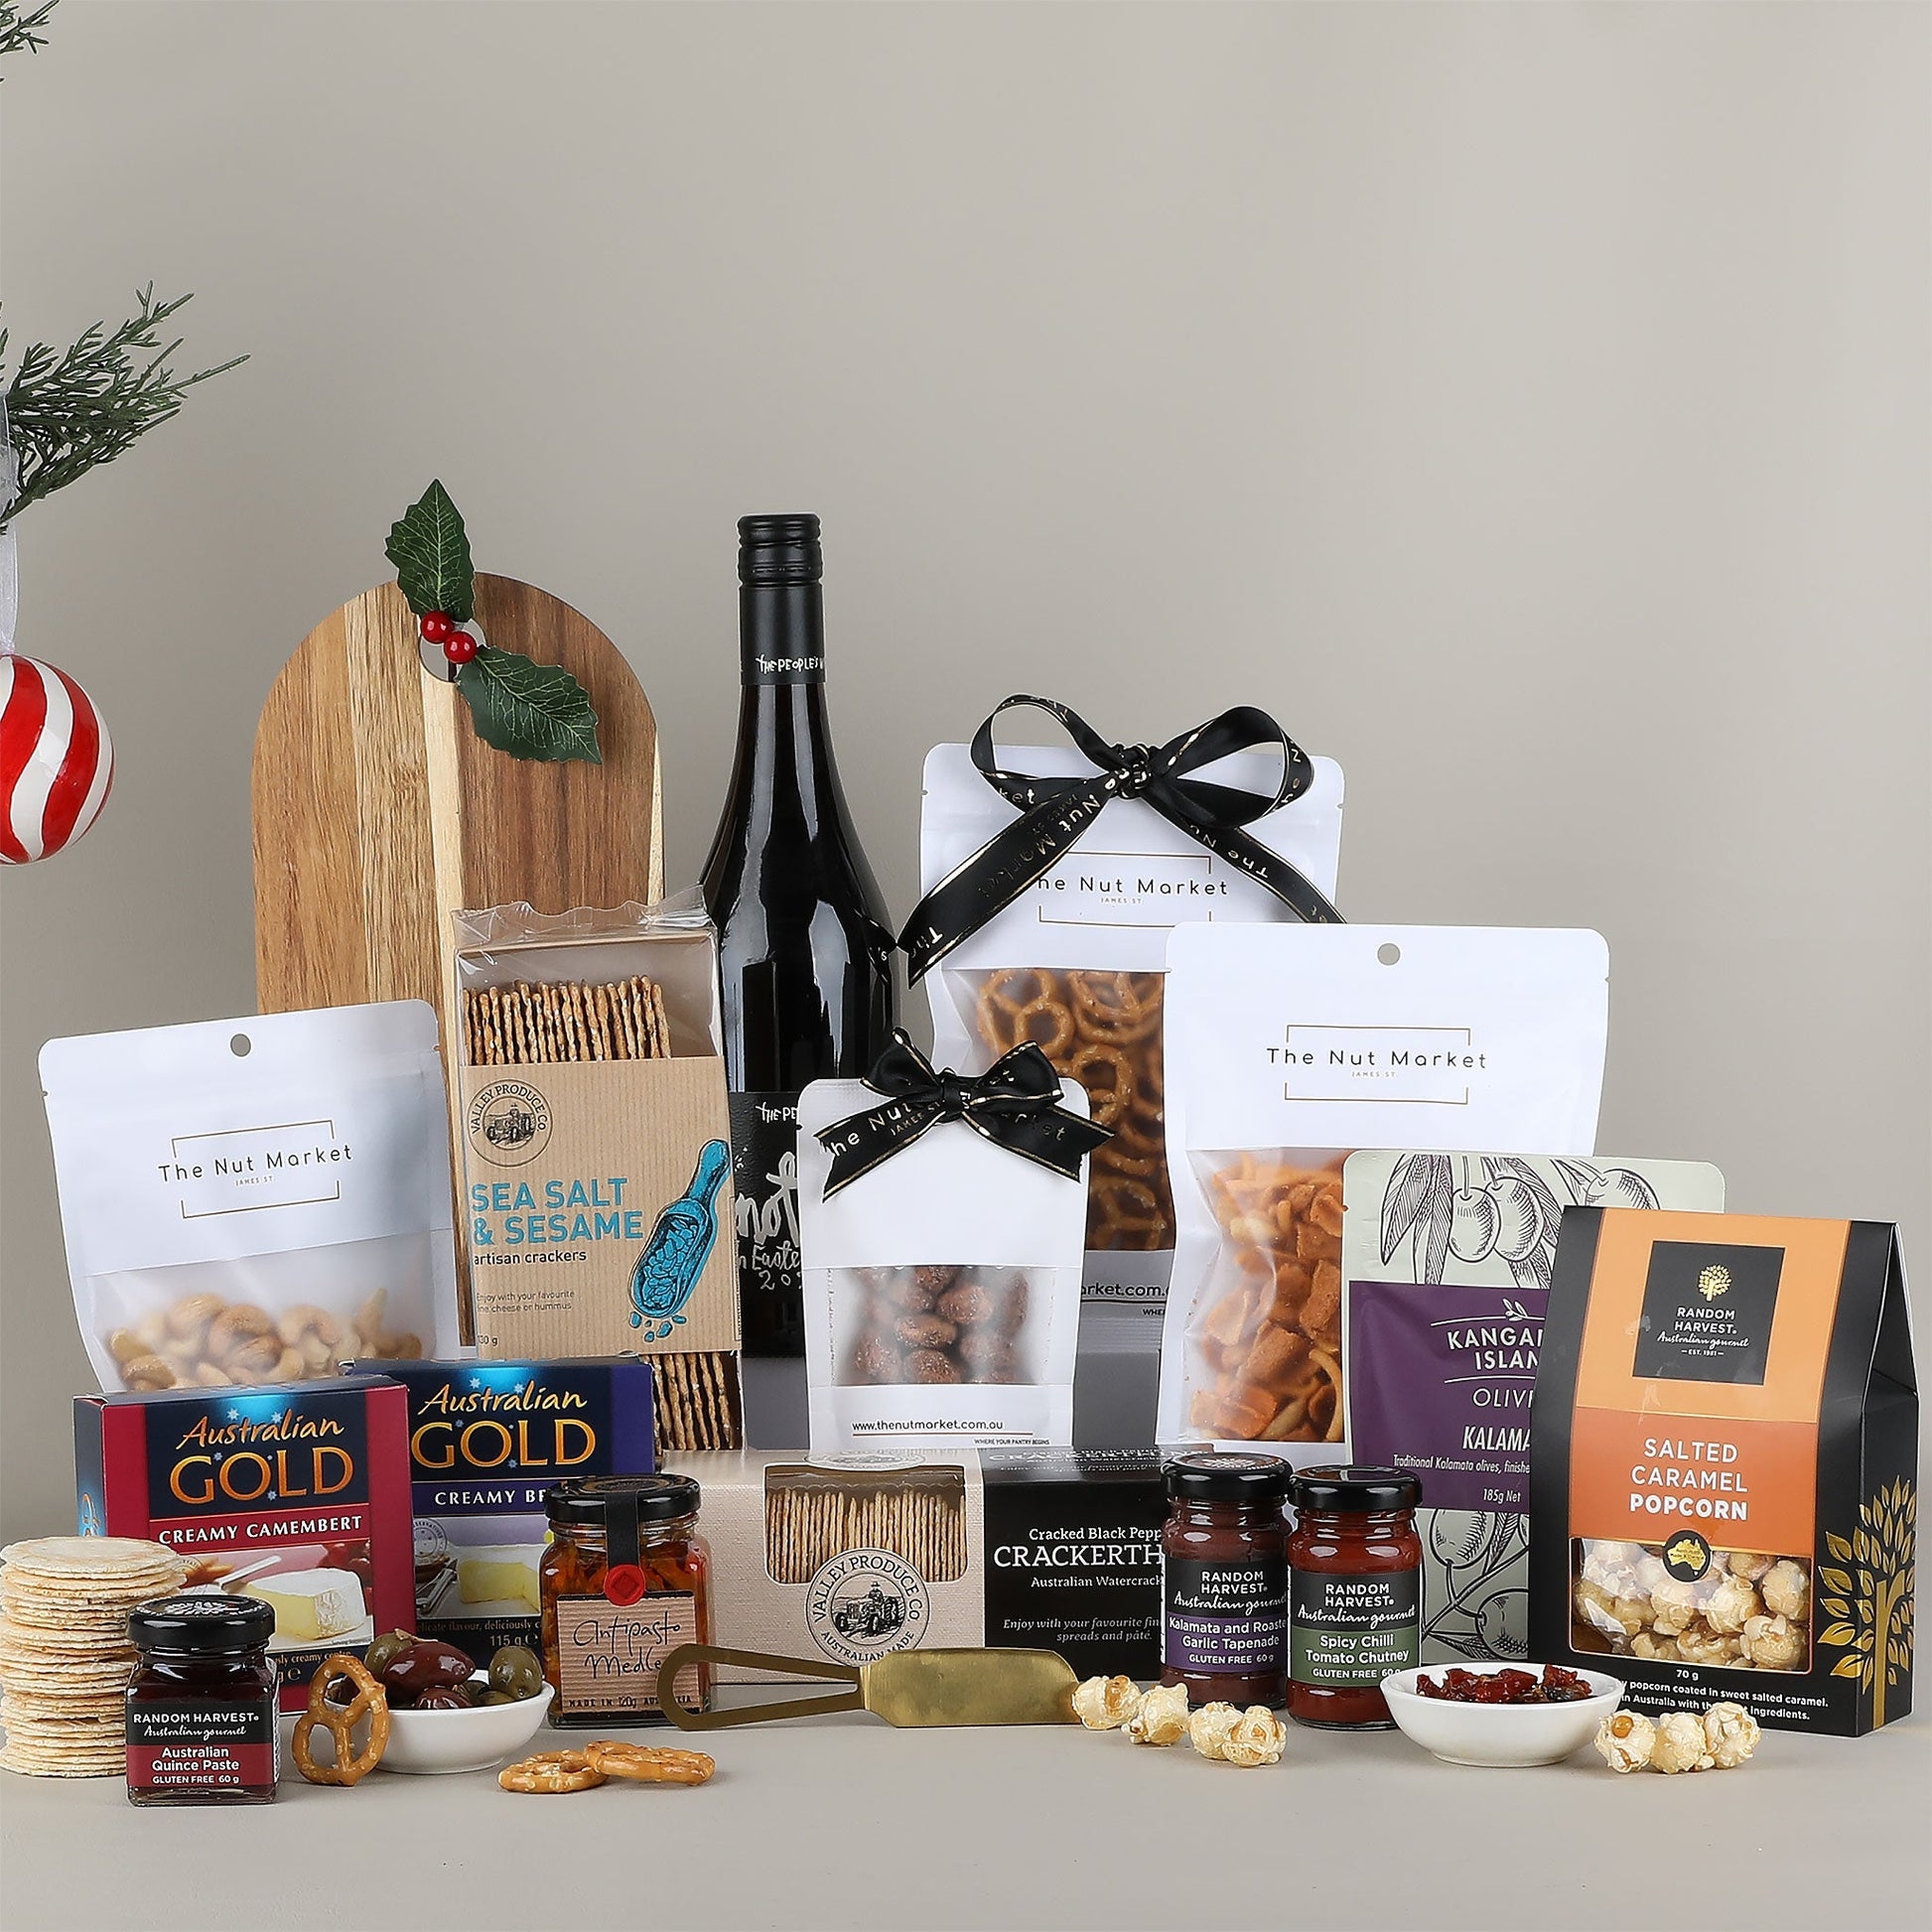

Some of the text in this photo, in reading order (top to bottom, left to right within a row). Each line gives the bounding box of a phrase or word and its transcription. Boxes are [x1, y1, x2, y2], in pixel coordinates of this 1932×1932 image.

[1058, 794, 1101, 833] Nut
[1080, 877, 1123, 893] Nut
[1138, 879, 1228, 896] Market
[1267, 1048, 1486, 1068] The Nut Market
[471, 1088, 497, 1135] VALLEY
[495, 1084, 545, 1114] PRODUCE
[159, 1145, 352, 1181] The Nut Market
[235, 1177, 260, 1186] JAMES
[472, 1177, 627, 1212] SEA SALT
[474, 1210, 642, 1245] & SESAME
[475, 1250, 587, 1265] artisan crackers
[517, 1293, 536, 1302] your
[537, 1290, 575, 1300] favourite
[1677, 1307, 1735, 1320] RANDOM
[491, 1336, 498, 1346] g
[1657, 1330, 1749, 1350] Australian gourmet
[418, 1380, 588, 1416] Australian
[175, 1409, 345, 1450] Australian
[852, 1419, 1004, 1431] www.thenutmarket.com.au
[410, 1418, 597, 1469] GOLD
[1644, 1438, 1737, 1462] SALTED
[1393, 1453, 1434, 1468] Traditional
[1436, 1456, 1473, 1470] Kalamata
[1475, 1458, 1502, 1474] olives,
[169, 1446, 354, 1504] GOLD
[1631, 1464, 1747, 1492] CARAMEL
[435, 1489, 516, 1505] CREAMY
[1483, 1488, 1521, 1503] 185g Net
[1630, 1493, 1747, 1520] POPCORN
[158, 1515, 362, 1545] CREAMY CAMEMBERT
[1029, 1528, 1085, 1541] Cracked
[1088, 1527, 1126, 1540] Black
[994, 1544, 1163, 1568] CRACKERTH
[1031, 1577, 1093, 1587] Australian
[1201, 1571, 1264, 1582] RANDOM
[811, 1562, 847, 1622] VALLEY
[849, 1555, 919, 1593] PRODUCE
[1325, 1584, 1390, 1595] RANDOM
[1174, 1590, 1245, 1609] Australian
[484, 1618, 531, 1631] deliciously
[1004, 1618, 1035, 1631] Enjoy
[1036, 1617, 1061, 1628] with
[1062, 1619, 1090, 1630] your
[1090, 1616, 1142, 1630] favourite
[1298, 1603, 1416, 1630] Australian gourmet
[1170, 1617, 1220, 1634] Kalamata
[1224, 1619, 1250, 1634] and
[490, 1634, 510, 1646] 115
[1056, 1630, 1099, 1643] spreads
[1101, 1629, 1123, 1641] and
[1182, 1634, 1280, 1652] Garlic Tapenade
[1319, 1633, 1394, 1650] Spicy Chilli
[820, 1630, 885, 1662] AUSTRALIAN
[291, 1653, 323, 1665] creamy
[1188, 1654, 1226, 1664] GLUTEN
[1228, 1655, 1252, 1664] FREE
[1256, 1653, 1268, 1663] 60
[1306, 1649, 1410, 1664] Tomato Chutney
[1312, 1668, 1350, 1678] GLUTEN
[1381, 1668, 1394, 1677] 60
[1676, 1669, 1699, 1681] 70 g
[1630, 1681, 1671, 1693] popcorn
[1673, 1685, 1707, 1697] coated
[1709, 1687, 1719, 1697] in
[1721, 1690, 1749, 1701] sweet
[1752, 1692, 1783, 1704] salted
[1784, 1695, 1829, 1708] caramel.
[569, 1699, 596, 1708] MADE
[601, 1698, 614, 1707] IN
[1633, 1694, 1676, 1707] Australia
[1678, 1699, 1699, 1710] with
[1749, 1706, 1811, 1721] ingredients.
[133, 1713, 191, 1724] RANDOM
[144, 1725, 246, 1740] Australian gourmet
[161, 1746, 229, 1759] Australian
[152, 1759, 240, 1772] Quince Paste
[152, 1775, 240, 1785] GLUTEN FREE 60 g
